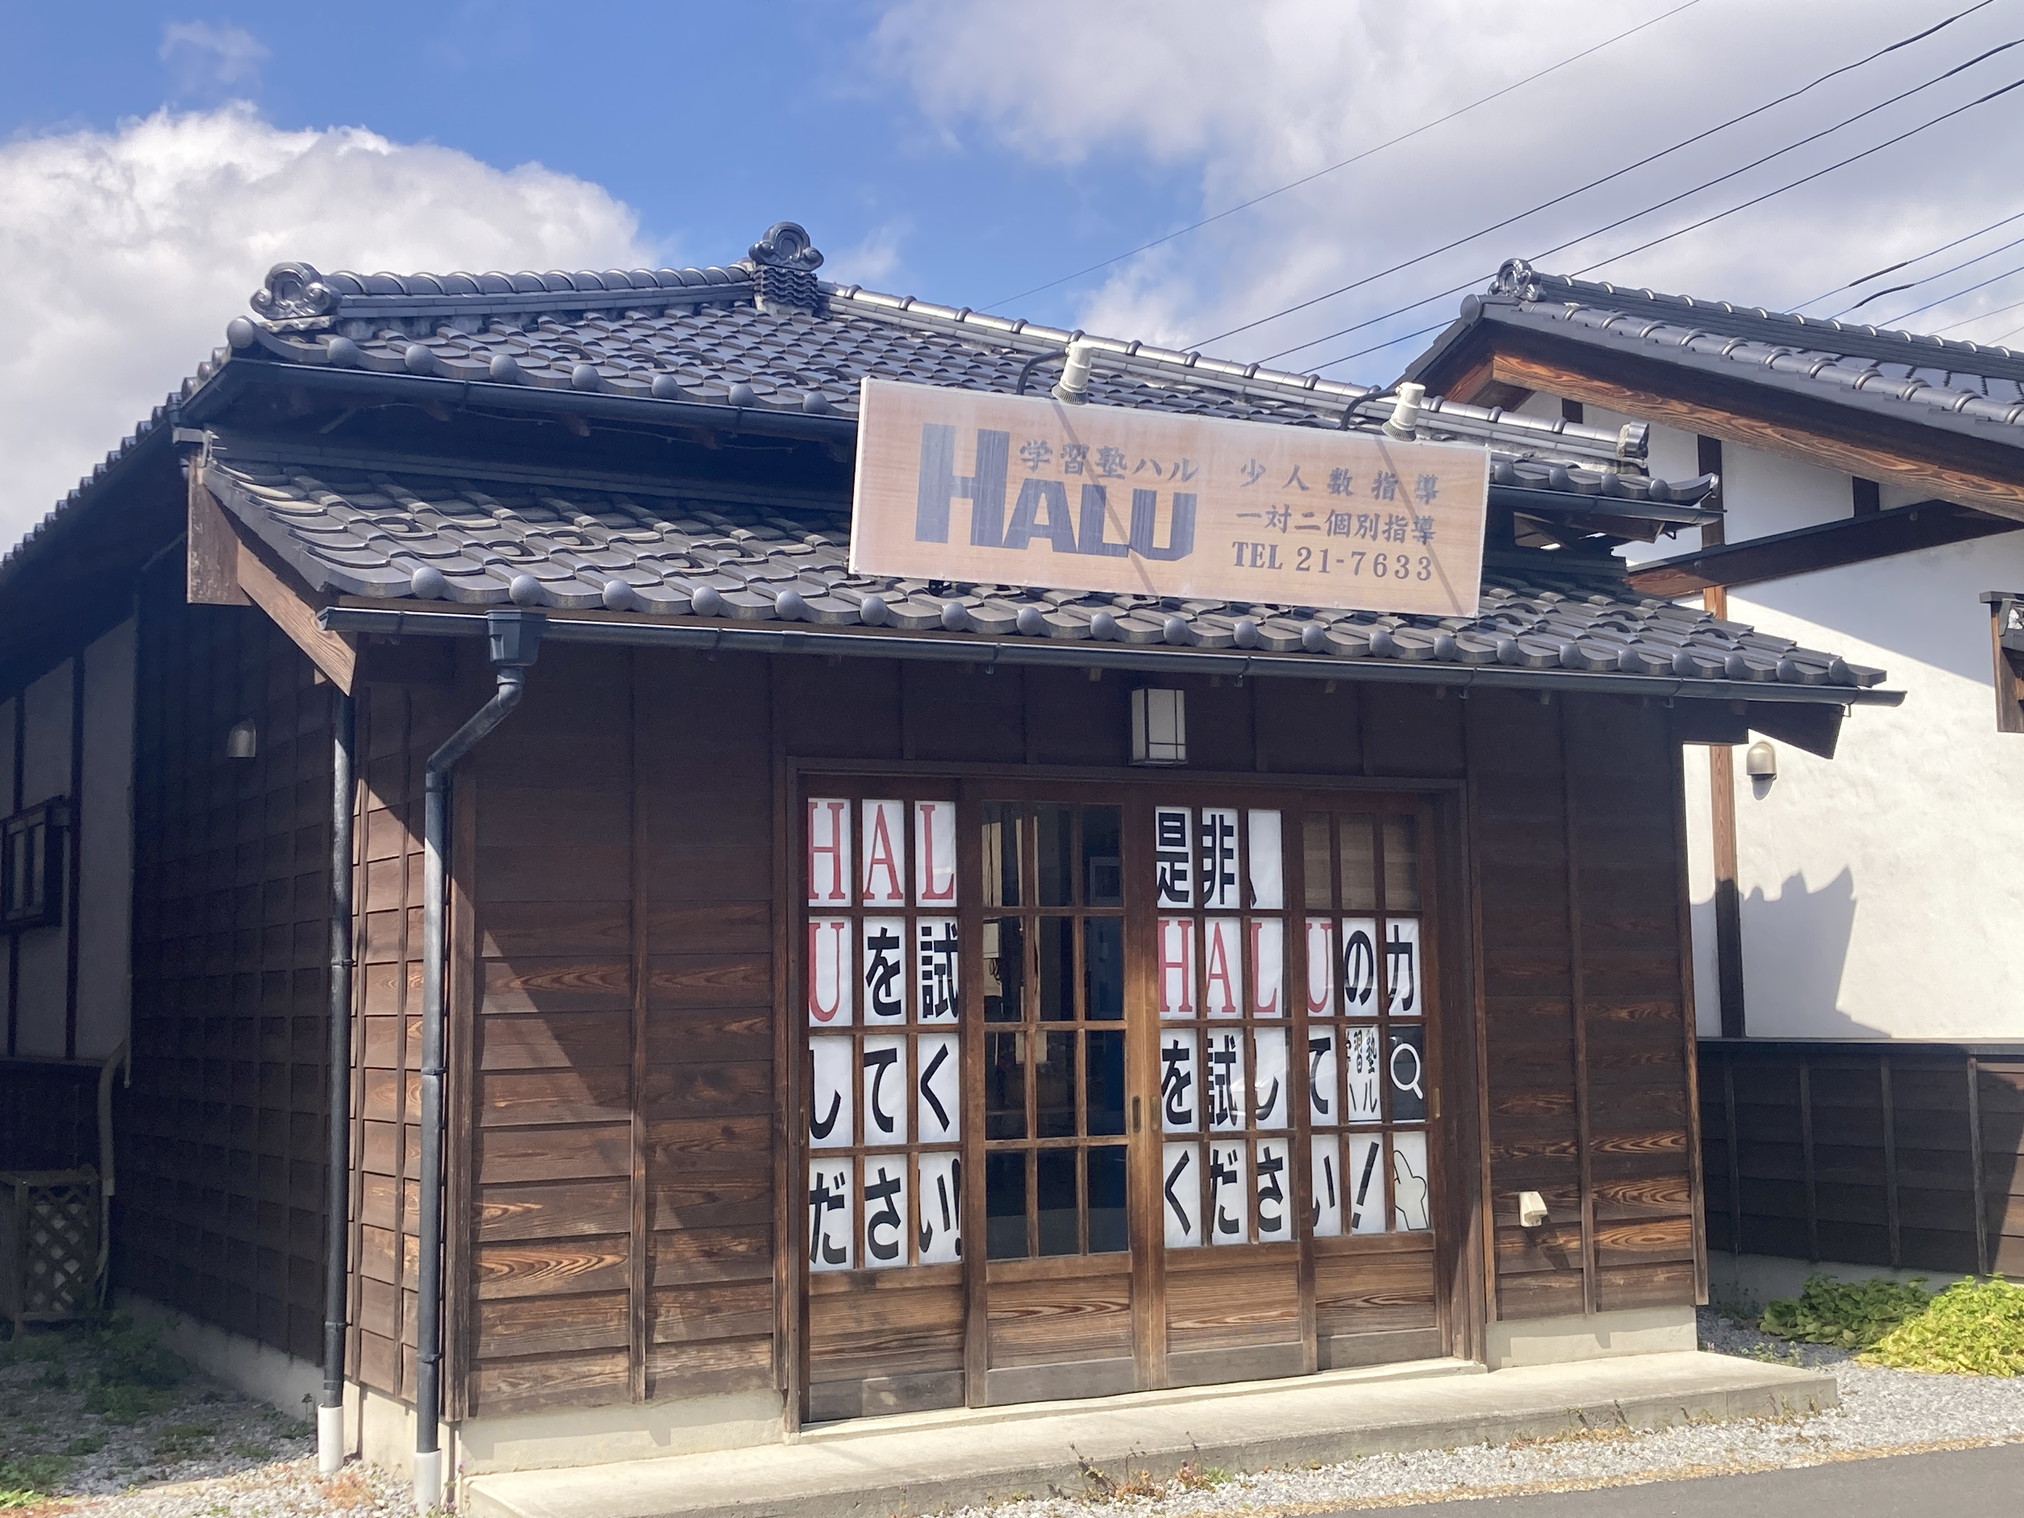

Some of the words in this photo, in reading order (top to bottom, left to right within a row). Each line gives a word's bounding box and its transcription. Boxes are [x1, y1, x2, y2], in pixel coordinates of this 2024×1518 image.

[1019, 439, 1199, 482] 学習塾ハル
[915, 423, 1198, 562] HALU
[1236, 503, 1436, 546] 一対二個別指導
[1232, 541, 1283, 570] TEL
[1295, 546, 1432, 581] 21-7633
